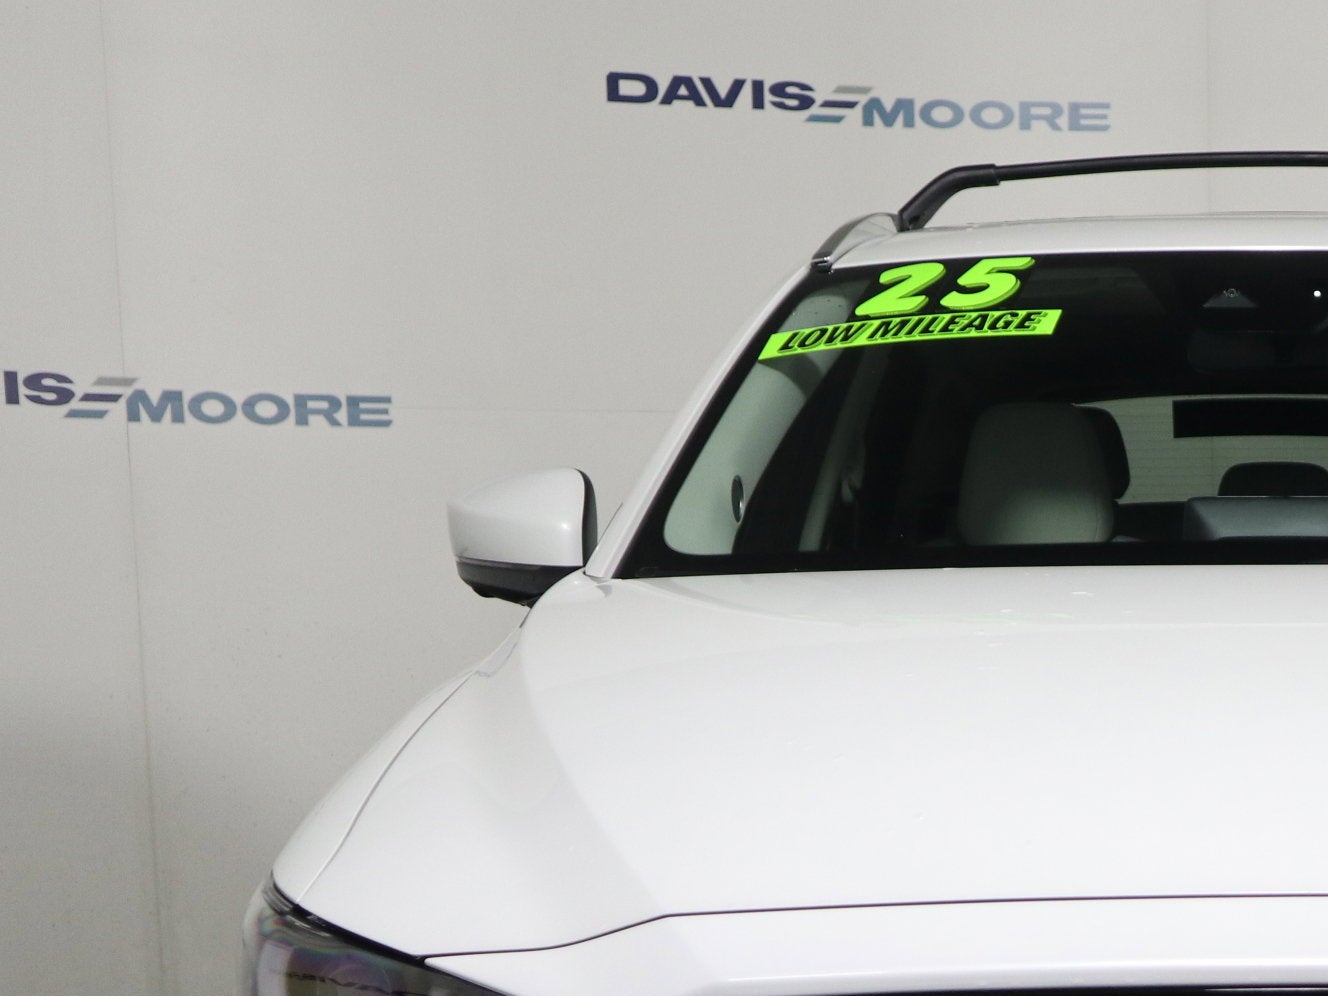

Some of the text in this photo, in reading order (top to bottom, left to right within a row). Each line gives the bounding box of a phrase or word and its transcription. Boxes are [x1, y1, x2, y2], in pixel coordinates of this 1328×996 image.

[606, 71, 1111, 133] DAVIS MOORE
[854, 256, 1036, 317] 25
[777, 310, 1048, 354] LOW MILEAGE
[126, 388, 394, 428] MOORE
